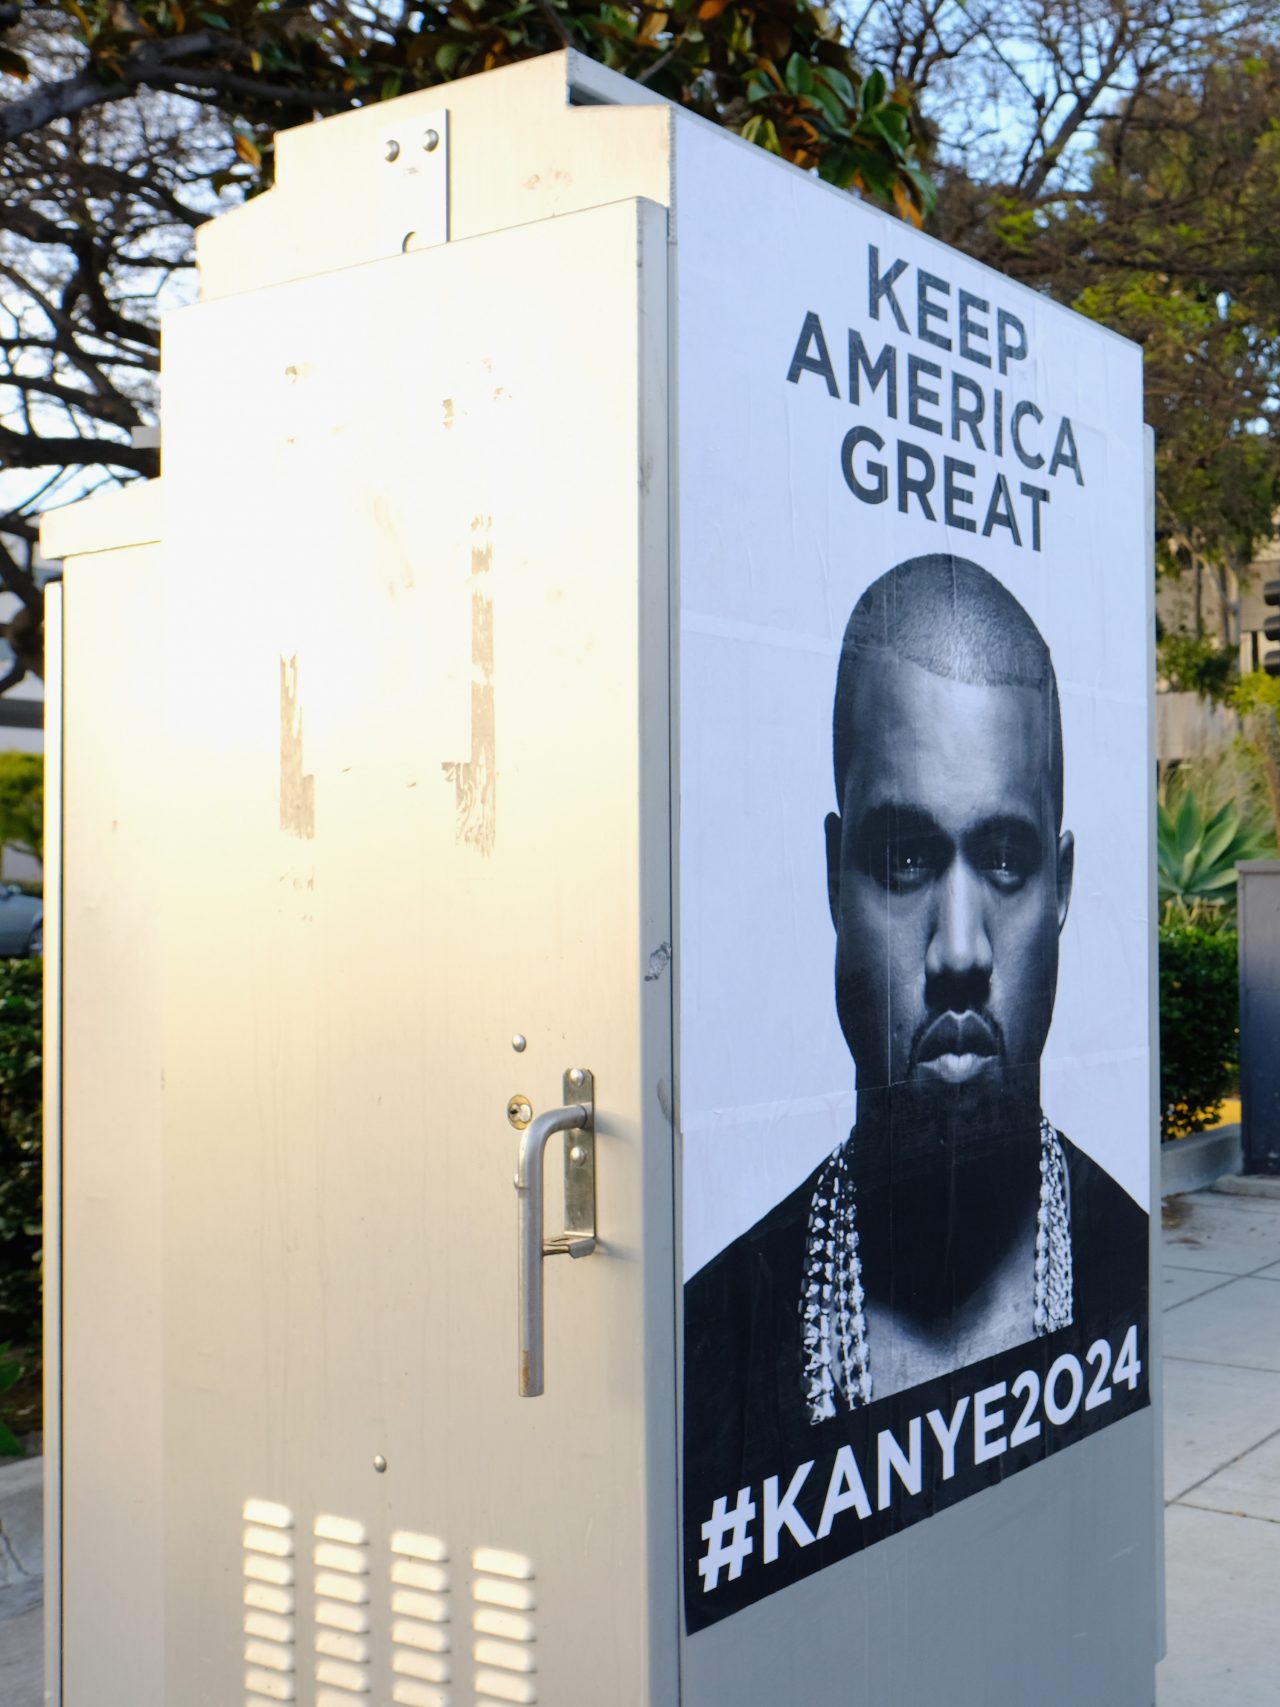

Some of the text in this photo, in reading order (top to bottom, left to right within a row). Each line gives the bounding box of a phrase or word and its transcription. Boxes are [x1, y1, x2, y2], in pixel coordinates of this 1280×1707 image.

[868, 243, 1029, 376] KEEP
[786, 310, 1084, 487] AMERICA
[841, 425, 1050, 552] GREAT
[698, 1325, 1141, 1593] #KANYE2024
